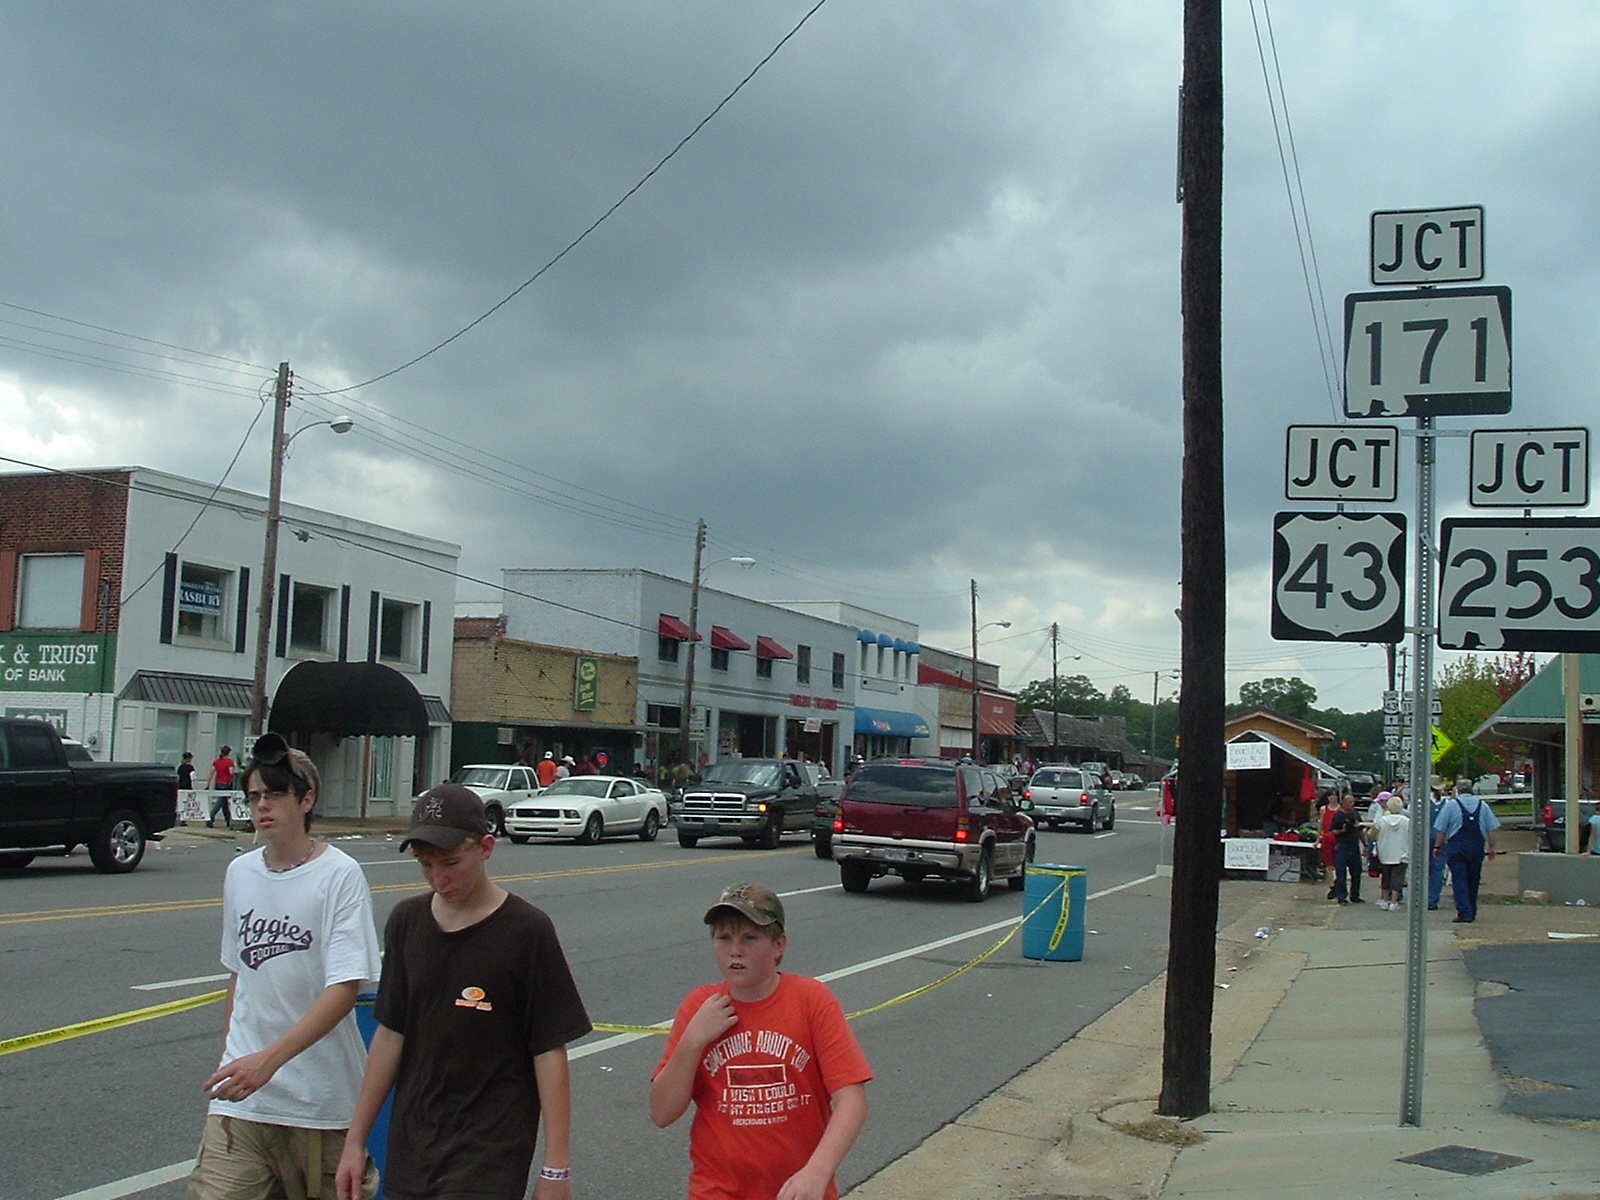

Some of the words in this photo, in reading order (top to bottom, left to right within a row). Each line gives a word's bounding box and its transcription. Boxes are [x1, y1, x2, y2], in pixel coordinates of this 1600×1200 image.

[1378, 219, 1475, 272] JCT
[1365, 317, 1488, 386] 171
[1292, 437, 1390, 488] JCT
[1477, 441, 1580, 493] JCT
[1283, 541, 1386, 611] 43
[1448, 546, 1600, 620] 253
[5, 668, 23, 681] OF
[28, 669, 66, 682] BANK
[13, 643, 30, 664] &
[38, 644, 99, 665] TRUST
[238, 908, 313, 947] Aggies
[250, 944, 292, 966] FOOTB
[703, 1030, 752, 1077] SOMETHING
[756, 1030, 793, 1060] ABOUT
[723, 1088, 727, 1102] I
[730, 1088, 756, 1102] WISH
[758, 1088, 763, 1101] I
[765, 1083, 796, 1101] COULD
[730, 1103, 744, 1116] MY
[746, 1101, 784, 1115] FINGER
[800, 1094, 811, 1106] IT
